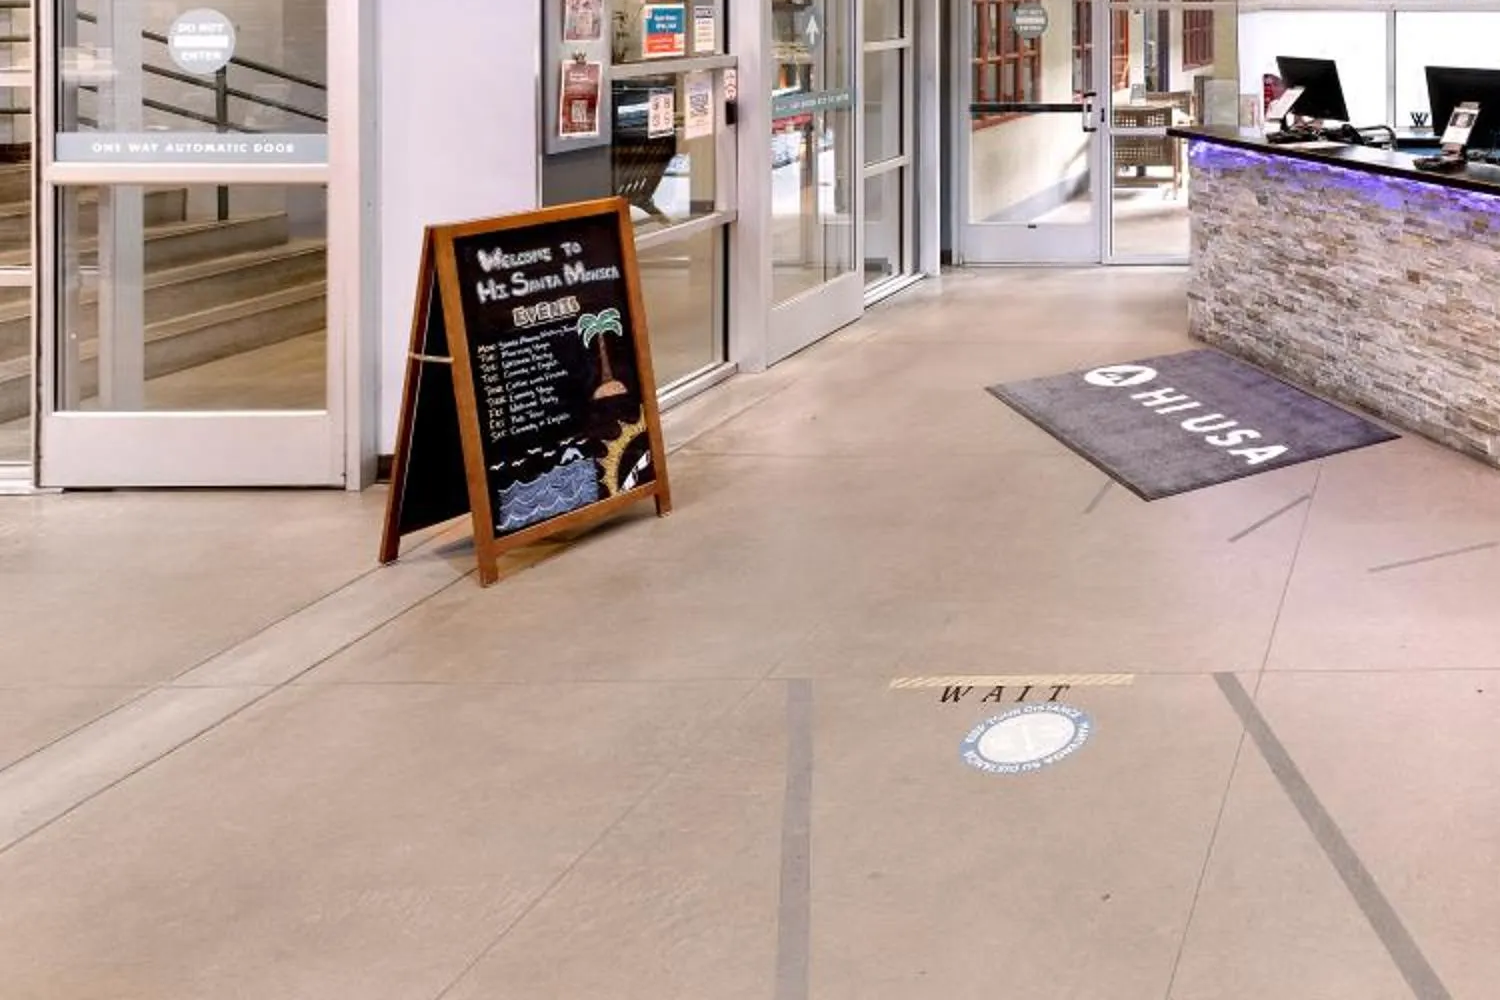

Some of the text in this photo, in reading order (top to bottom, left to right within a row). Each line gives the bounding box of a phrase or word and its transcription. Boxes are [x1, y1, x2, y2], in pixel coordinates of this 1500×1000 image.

[92, 143, 295, 153] ONE WAY AUTOMATIC DOOR
[1130, 387, 1289, 465] HI USA
[939, 684, 1071, 702] WAIT
